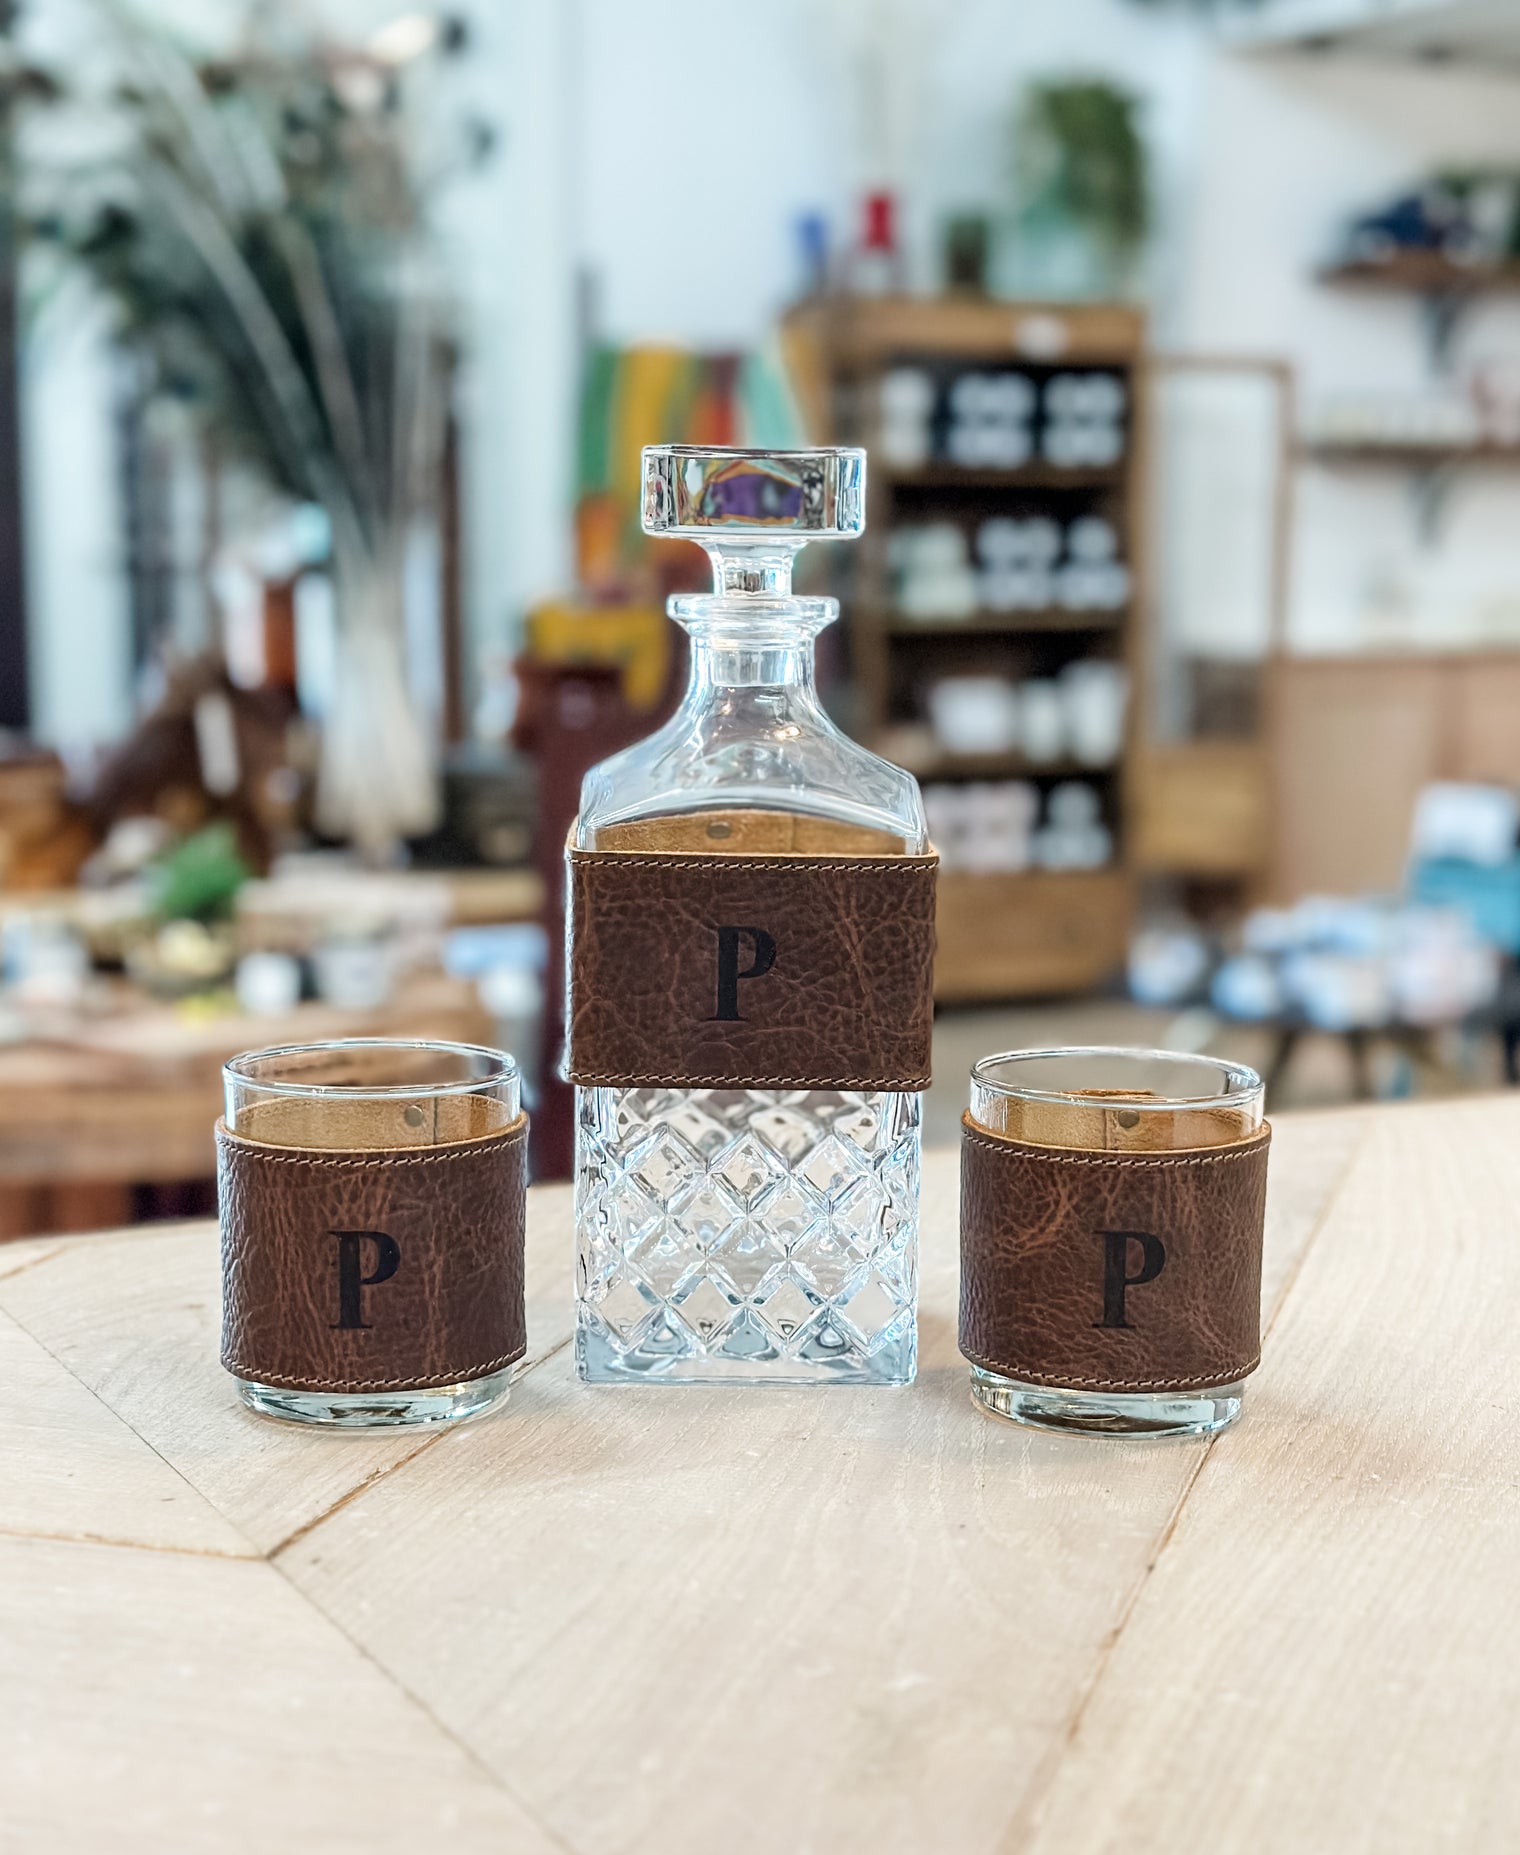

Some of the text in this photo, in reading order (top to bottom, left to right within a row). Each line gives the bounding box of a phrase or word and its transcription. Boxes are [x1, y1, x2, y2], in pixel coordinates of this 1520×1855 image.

[708, 926, 777, 1022] P
[328, 1230, 401, 1331] P
[1092, 1230, 1167, 1330] P
